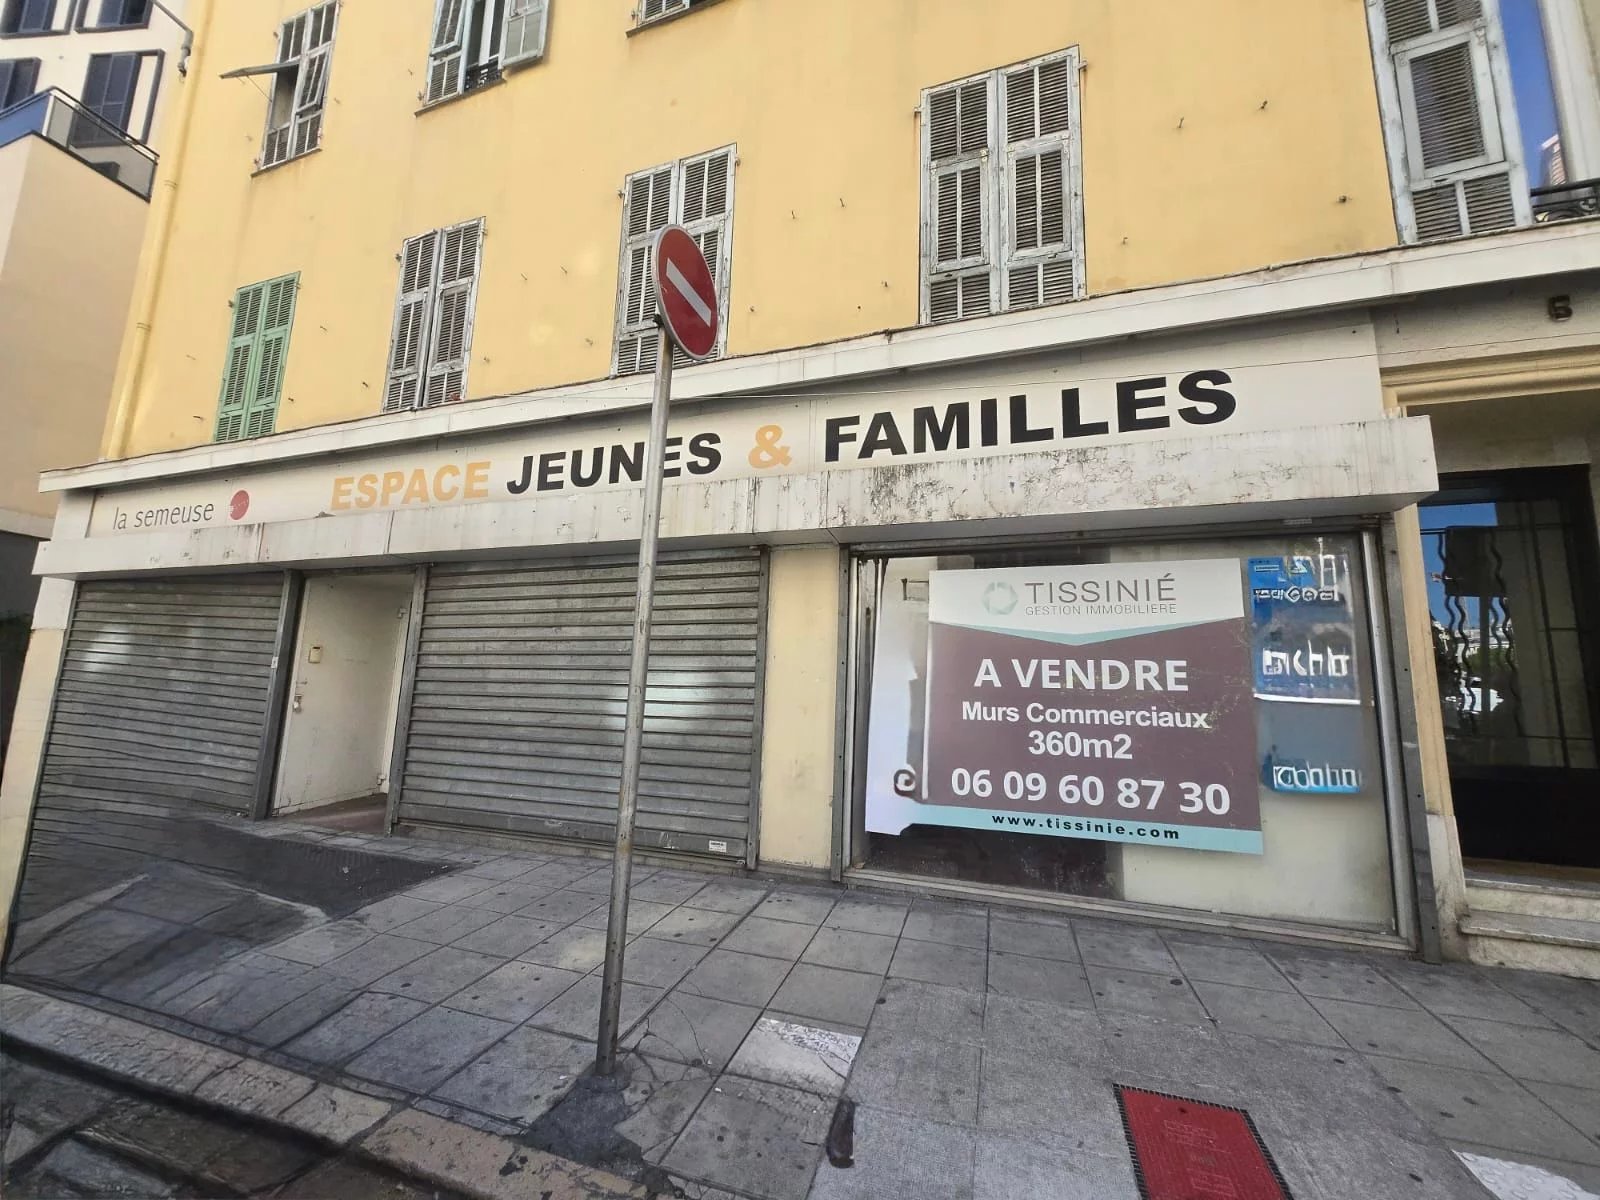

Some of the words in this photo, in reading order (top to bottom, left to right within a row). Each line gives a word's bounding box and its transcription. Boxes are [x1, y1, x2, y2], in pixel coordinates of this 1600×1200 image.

[330, 460, 492, 511] ESPACE
[506, 432, 722, 495] JEUNES
[748, 424, 793, 469] &
[824, 369, 1237, 463] FAMILLES
[112, 506, 128, 530] la
[133, 502, 215, 528] semeuse
[1024, 573, 1177, 604] TISSINIÉ
[1025, 604, 1081, 616] GESTION
[1086, 603, 1177, 615] IMMOBILIERE
[973, 658, 1002, 688] A
[1011, 658, 1189, 691] VENDRE
[962, 701, 1020, 722] Murs
[1026, 702, 1213, 729] Commerciaux
[1028, 730, 1133, 760] 360m2
[951, 767, 993, 798] 06
[1003, 770, 1047, 801] 09
[1058, 774, 1104, 806] 60
[1117, 777, 1165, 810] 87
[1178, 781, 1231, 815] 30
[991, 814, 1180, 840] www.tissinie.com
